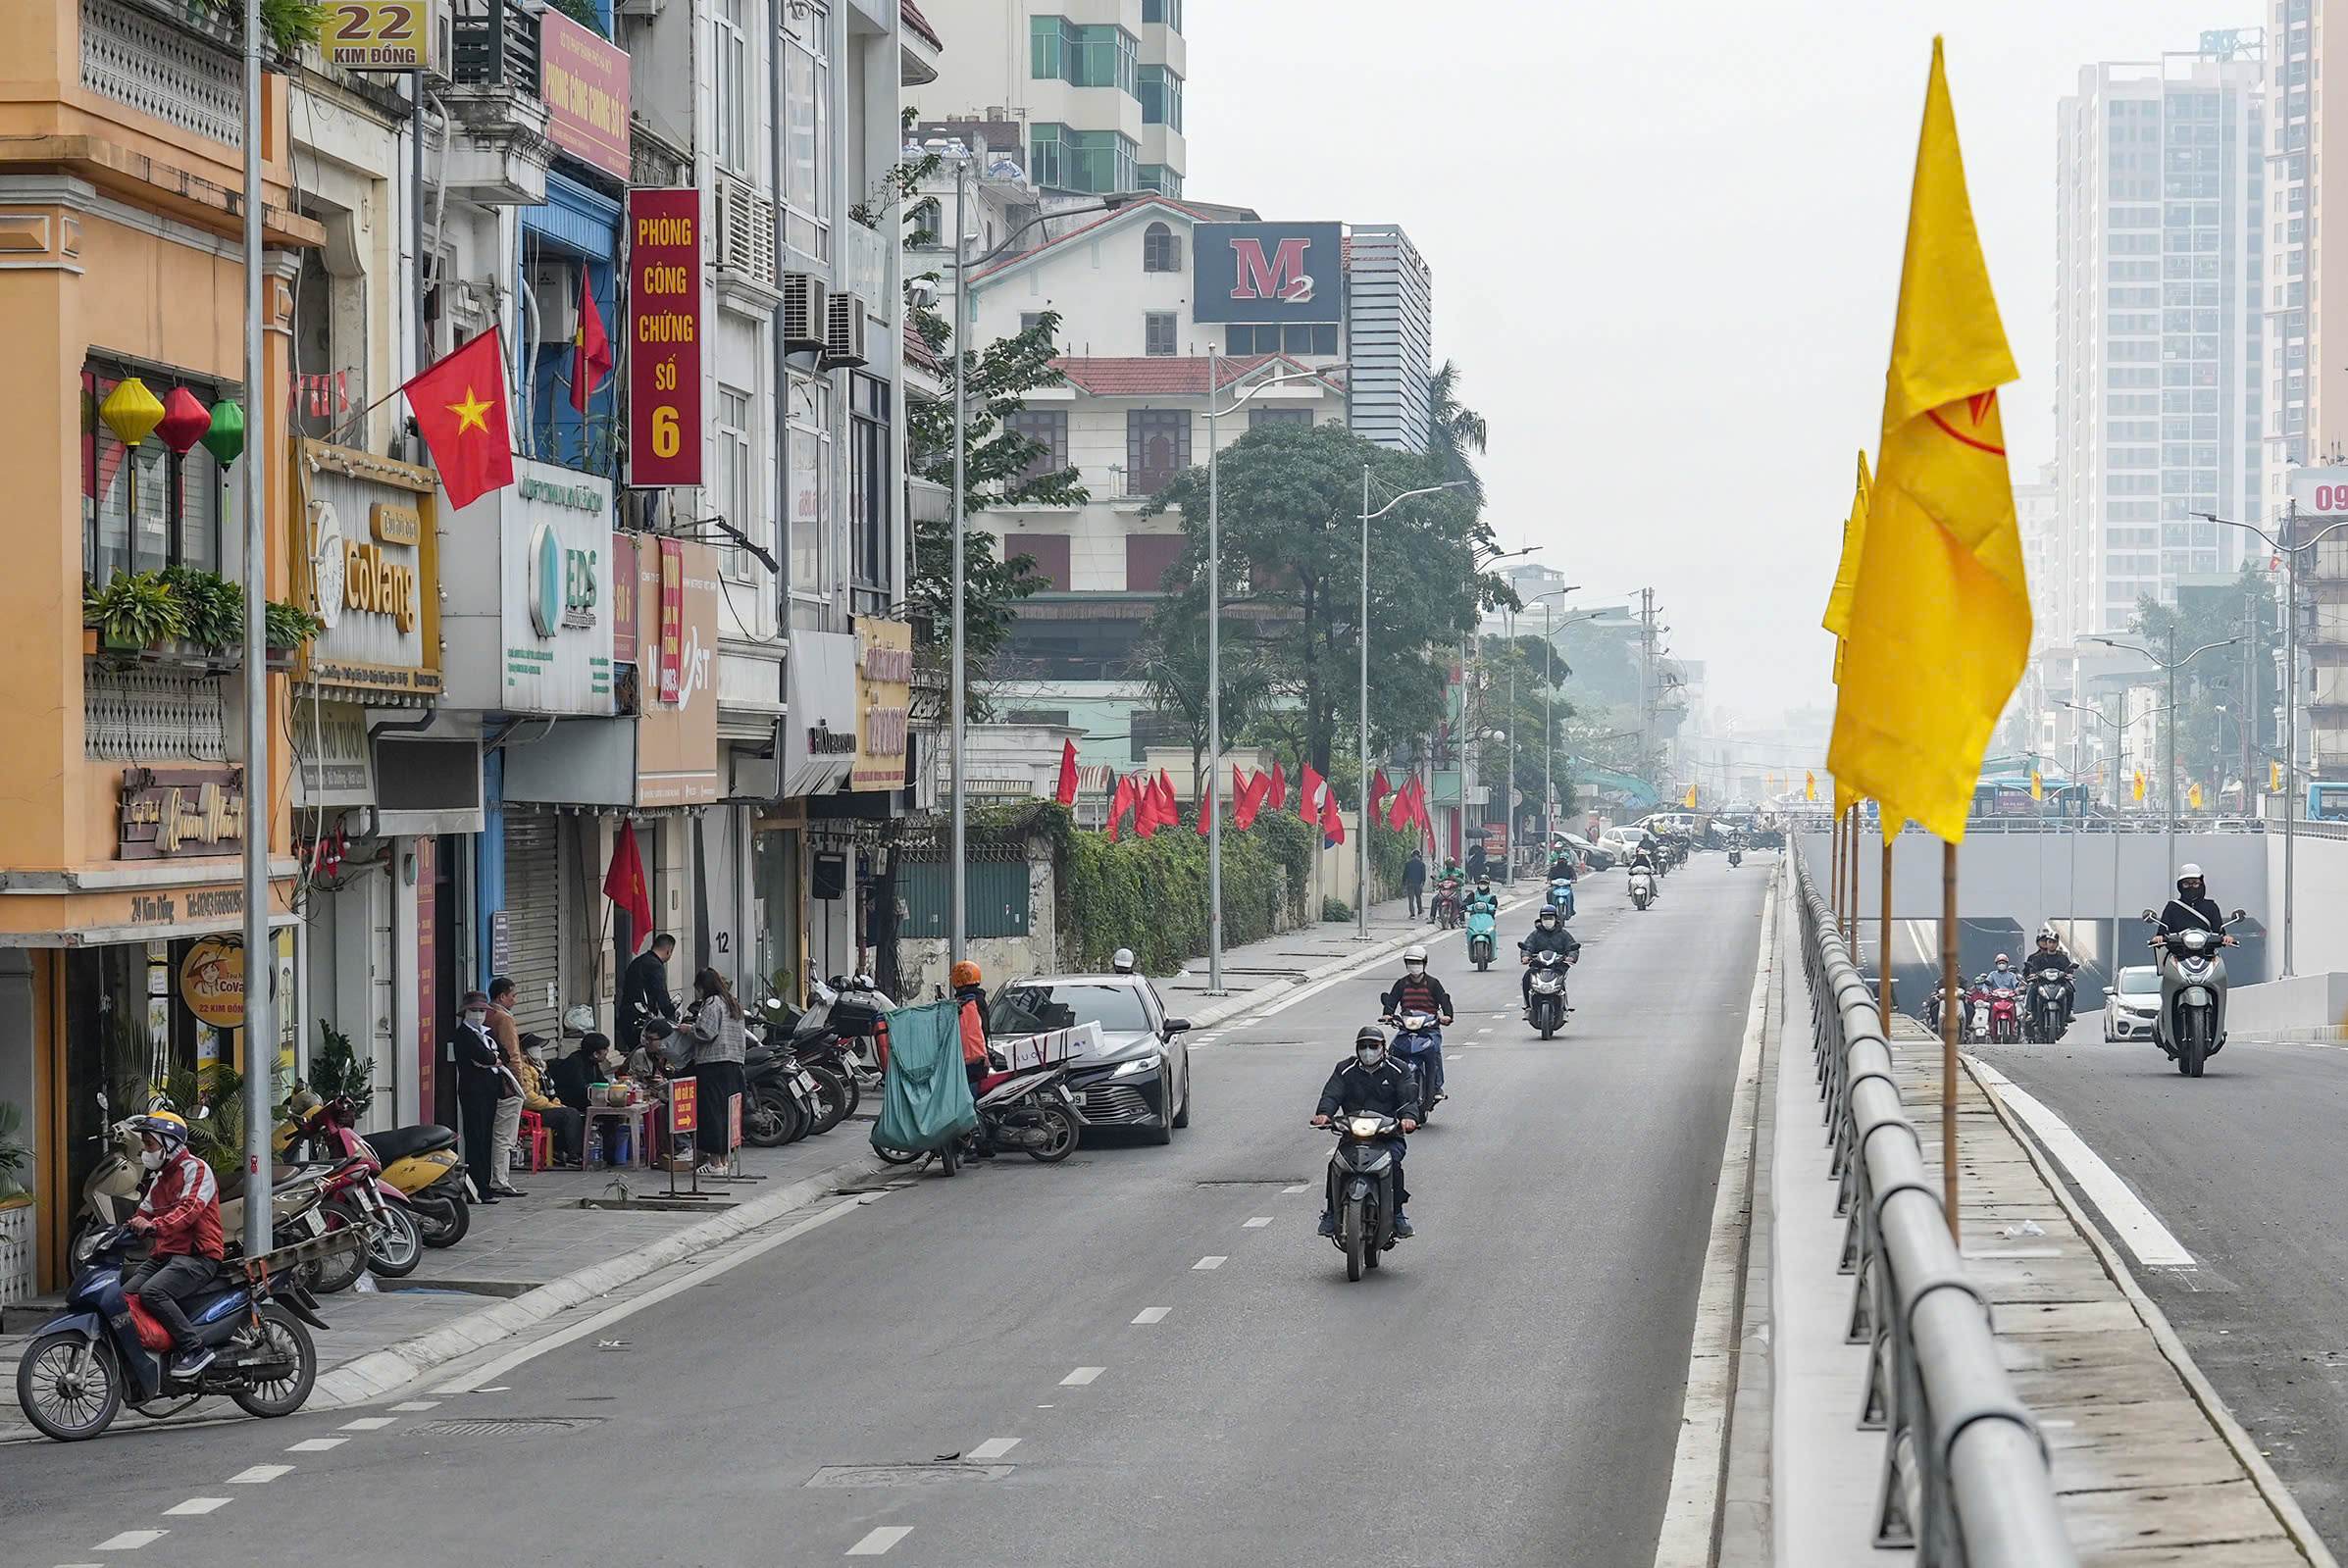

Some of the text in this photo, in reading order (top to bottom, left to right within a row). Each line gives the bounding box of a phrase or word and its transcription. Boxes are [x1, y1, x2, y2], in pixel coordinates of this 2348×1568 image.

[336, 5, 415, 40] 22
[334, 42, 416, 64] KIM ĐỒNG
[570, 69, 588, 122] CÔNG
[611, 87, 620, 139] SỐ
[620, 102, 626, 141] 6
[638, 212, 691, 246] PHÒNG
[643, 261, 687, 294] CÔNG
[638, 309, 693, 342] CHỨNG
[655, 353, 677, 391] SỐ
[651, 405, 681, 458] 6
[346, 540, 416, 633] CoVang
[565, 548, 597, 608] EDS
[131, 897, 141, 923] 24
[142, 896, 156, 923] Kim
[716, 932, 729, 953] 12
[220, 980, 243, 992] CoVa
[198, 1002, 243, 1013] 22 KIM ĐỒN
